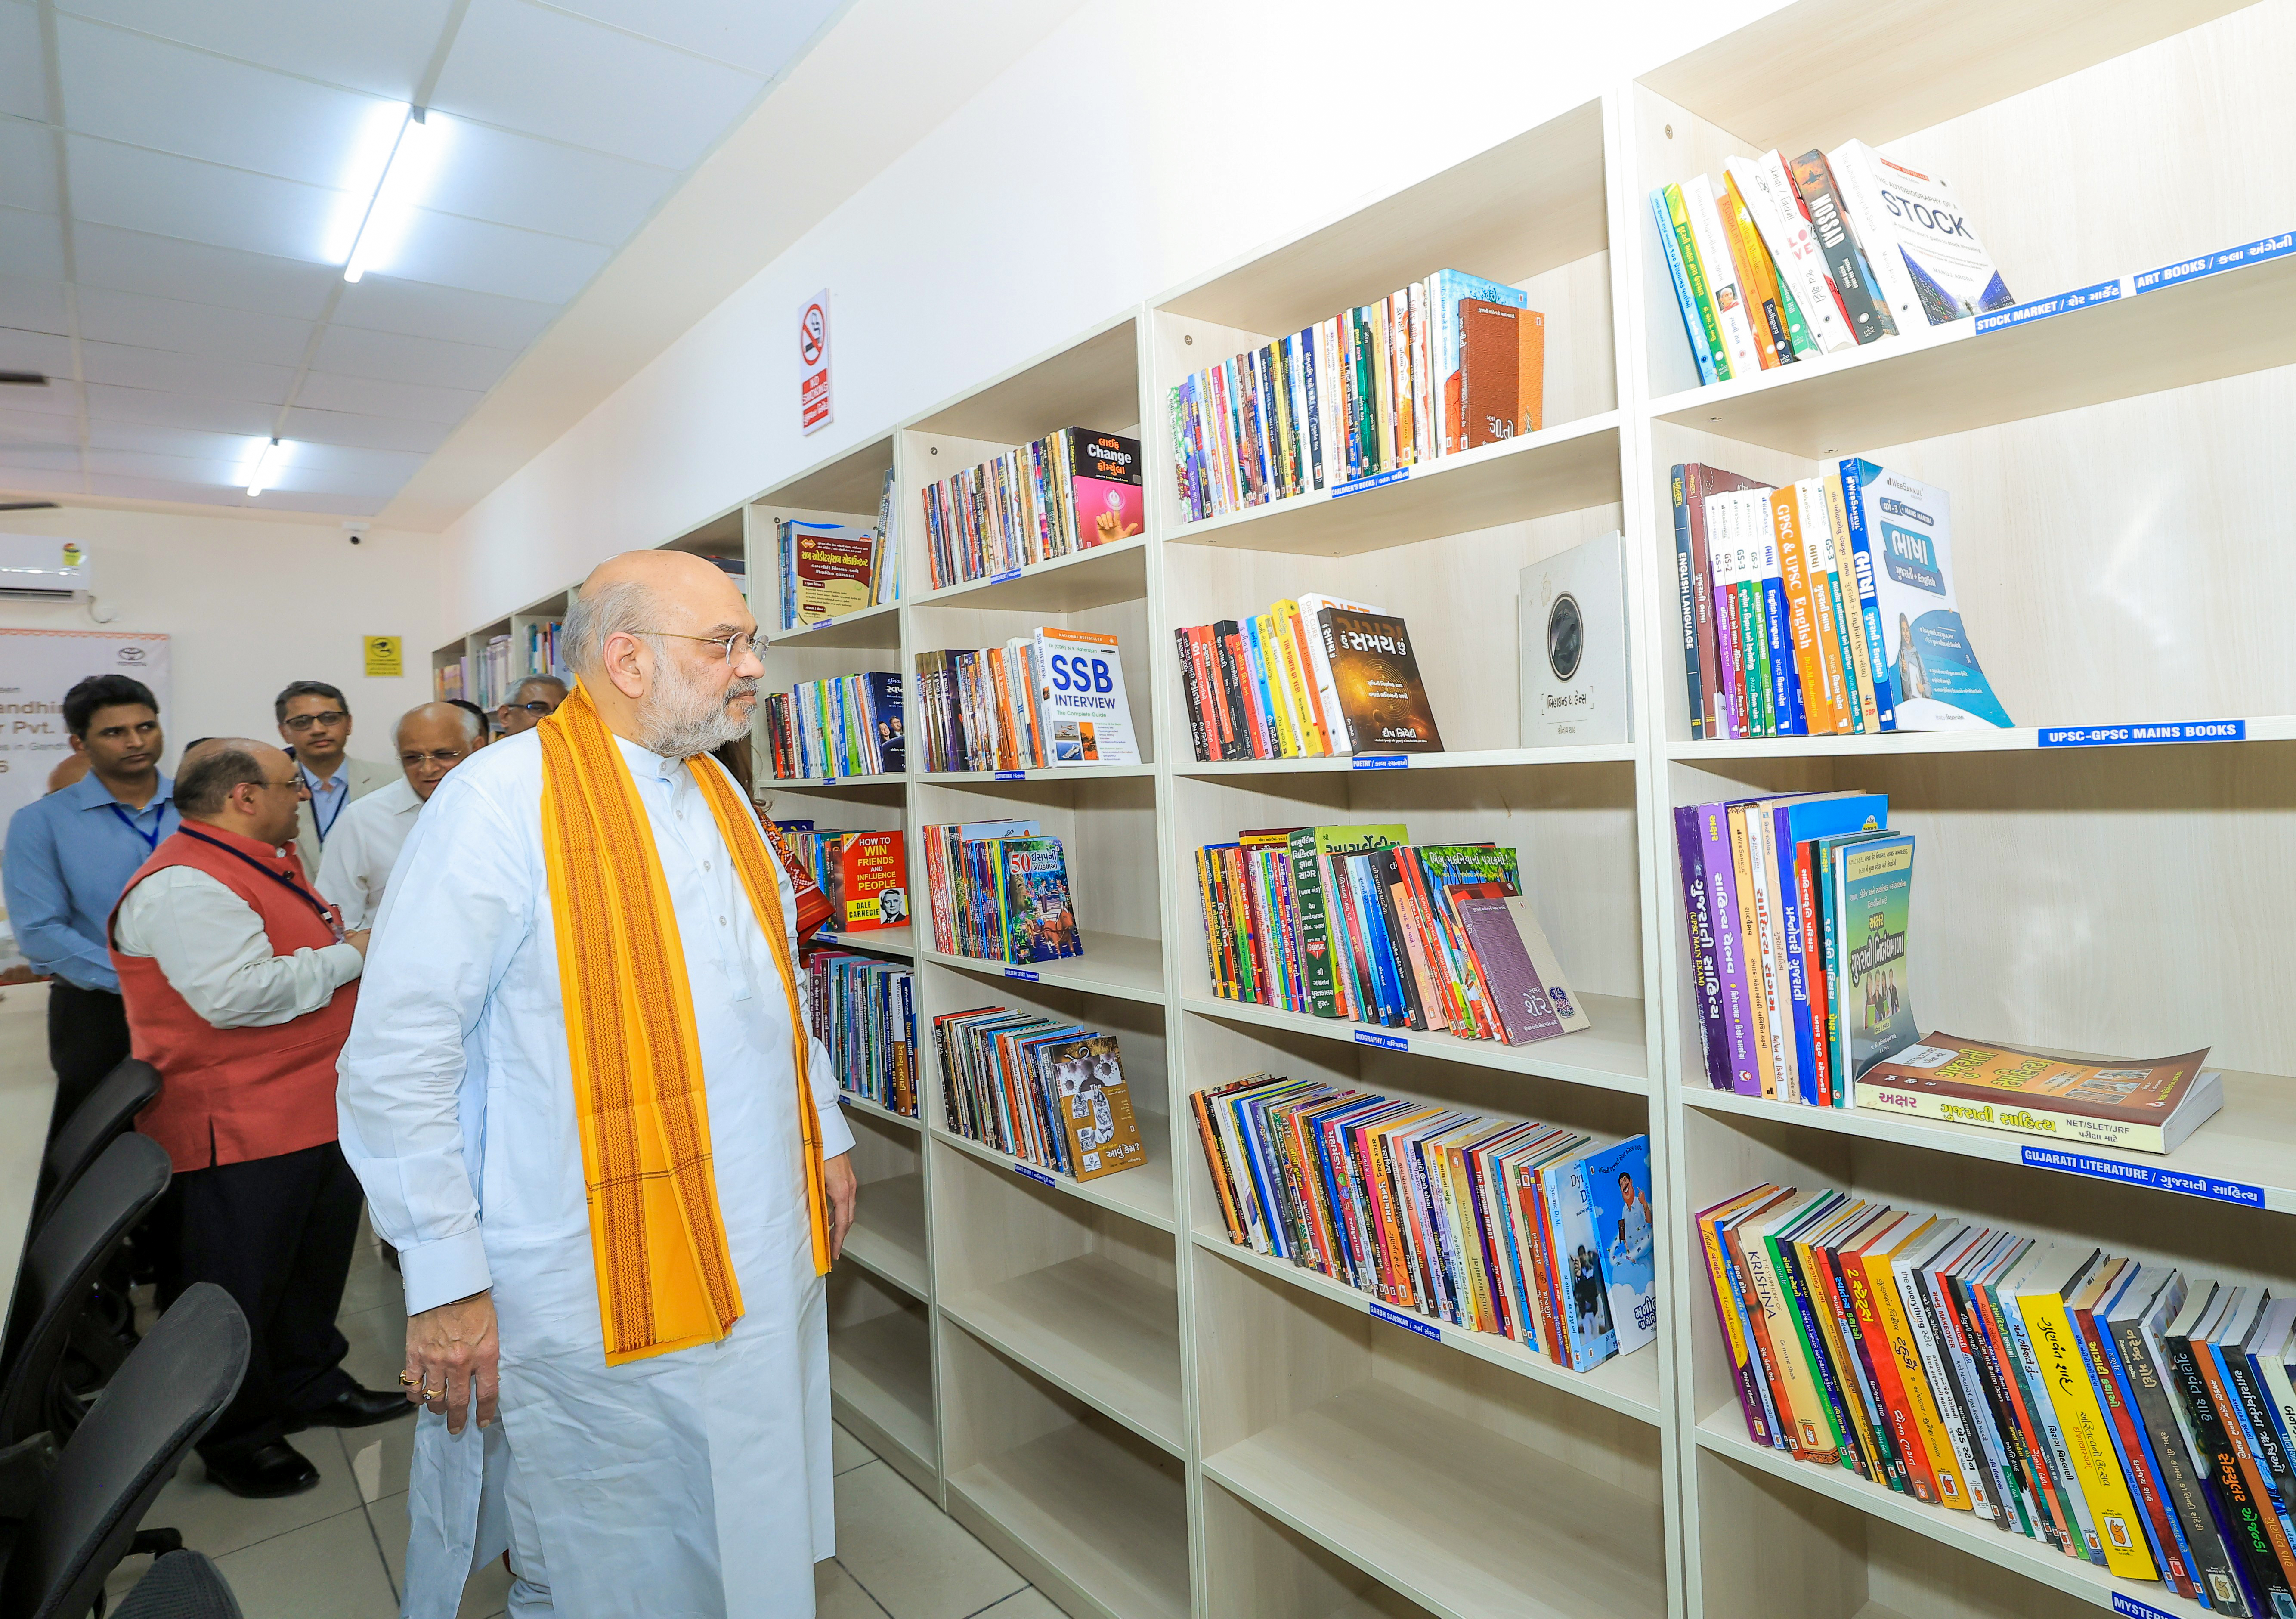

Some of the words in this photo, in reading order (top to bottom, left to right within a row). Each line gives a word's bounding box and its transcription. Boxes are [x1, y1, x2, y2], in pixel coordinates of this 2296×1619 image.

[1881, 158, 1902, 171] NATIONAL
[1902, 167, 1929, 181] BESTSELLER
[1875, 174, 1888, 185] THE
[1890, 181, 1941, 204] AUTOBIOGRAPHY
[1722, 201, 1742, 245] KUNDALINI
[1810, 192, 1845, 249] MOSSAD
[1881, 190, 1974, 240] STOCK
[2137, 273, 2160, 288] ART
[2164, 259, 2206, 282] BOOKS
[2218, 251, 2243, 265] કલા
[2250, 234, 2292, 256] અંગેની
[1933, 267, 1953, 277] MANOJ
[1955, 274, 1974, 282] ARORA
[1767, 303, 1779, 335] Sadhguru
[1977, 313, 2011, 331] STOCK
[2014, 300, 2058, 322] MARKET
[2067, 295, 2085, 306] શેર
[802, 381, 828, 404] SMOKING
[809, 375, 820, 388] NO
[1489, 419, 1514, 439] ગીતો
[1087, 443, 1132, 465] Change
[1098, 437, 1120, 451] લાઈફ
[1332, 483, 1358, 496] CHILDREN'S
[1359, 479, 1374, 489] BOOKS
[1392, 471, 1408, 481] સાહિત્ય
[1777, 504, 1795, 539] GPSC
[1904, 506, 1916, 520] MAINS
[1917, 511, 1932, 524] MANTRA
[1784, 542, 1797, 553] &
[1892, 529, 1928, 566] ભાષા
[1737, 549, 1746, 570] GS-3
[1679, 552, 1691, 594] ENGLISH
[1786, 555, 1803, 590] UPSC
[1855, 551, 1875, 598] ભાષા
[1895, 565, 1913, 584] ગુજરાતી
[1917, 576, 1936, 588] English
[1767, 589, 1779, 614] English
[1682, 595, 1696, 649] LANGUAGE
[1769, 615, 1782, 649] Language
[1794, 597, 1814, 648] English
[1076, 645, 1097, 653] Natarajan
[1340, 630, 1350, 649] હું
[1348, 631, 1396, 654] સમય
[1396, 638, 1407, 656] છું
[1287, 651, 1296, 671] POWER
[1051, 654, 1113, 693] SSB
[1055, 694, 1115, 709] INTERVIEW
[1547, 693, 1568, 709] બિહાઇન્ડ
[1569, 697, 1574, 706] ધ
[1575, 690, 1587, 704] લેન્સ
[1865, 708, 1876, 716] CBP
[13, 721, 55, 734] Pvt.
[2049, 729, 2128, 742] UPSC-GPSC
[2133, 726, 2180, 739] MAINS
[2186, 724, 2236, 737] BOOKS
[859, 838, 879, 846] HOW
[864, 845, 887, 857] WIN
[1290, 835, 1314, 847] આયુર્વેદીય
[858, 856, 894, 867] FRIENDS
[1011, 853, 1031, 873] 50
[1031, 848, 1057, 861] ઈસપની
[1292, 849, 1316, 860] ચિકિત્સા
[1298, 860, 1313, 870] જ્ઞાન
[1482, 853, 1509, 865] પરાક્રમો!
[857, 871, 896, 881] INFLUENCE
[1033, 862, 1058, 871] બોધકથાઓ
[1297, 870, 1316, 879] સાગર
[858, 879, 896, 891] PEOPLE
[849, 908, 879, 919] CARNEGIE
[857, 901, 871, 910] DALE
[1689, 877, 1714, 950] ગુજરાતી
[1690, 911, 1701, 935] (UPSC
[1756, 887, 1774, 955] સાહિત્ય
[1869, 914, 1884, 929] અક્ષર
[1308, 942, 1325, 950] Gajanan
[1693, 936, 1703, 958] MAIN
[1851, 938, 1873, 984] ગુજરાતી
[1875, 933, 1904, 964] નિબંધમાળા
[1696, 959, 1707, 987] EXAM)
[1764, 962, 1780, 1012] સંગમ
[1356, 1033, 1382, 1044] BIOGRAPHY
[897, 1044, 906, 1066] રેવન્યુ
[1878, 1092, 1917, 1108] અક્ષર
[1940, 1103, 1994, 1122] ગુજરાતી
[2000, 1111, 2057, 1133] સાહિત્ય
[2066, 1119, 2130, 1134] NET/SLET/JRF
[1106, 1147, 1123, 1159] આવું
[1124, 1143, 1140, 1155] કેમ?
[2024, 1150, 2077, 1168] GUJARATI
[2080, 1158, 2149, 1181] LITERATURE
[2160, 1174, 2207, 1192] ગુજરાતી
[2212, 1186, 2257, 1201] સાહિત્ય
[1380, 1181, 1393, 1222] પુનરાગમન
[1479, 1184, 1488, 1214] COMPOUND
[1485, 1216, 1494, 1239] IMPACT
[1750, 1250, 1776, 1318] KRISHNA
[1847, 1267, 1860, 1278] 2
[1902, 1271, 1911, 1283] the
[1767, 1270, 1779, 1302] SYMPHONY
[1776, 1303, 1782, 1311] OF
[1848, 1278, 1878, 1324] સ્ટેટ્સ
[1906, 1284, 1926, 1328] everything
[1370, 1306, 1386, 1318] GARBH
[1387, 1313, 1409, 1328] SANSKAR
[1413, 1324, 1423, 1332] ગર્ભ
[1424, 1328, 1440, 1339] સંસ્કાર
[1939, 1309, 1956, 1348] MAKEOVER
[1922, 1329, 1934, 1347] સ્ટોર
[2037, 1315, 2067, 1361] ગુણવંત
[2055, 1361, 2076, 1397] શાહ
[2089, 1340, 2109, 1375] આઝાદી
[2102, 1376, 2121, 1408] કથાઓ
[2216, 1451, 2249, 1504] સેક્યુલર
[2241, 1505, 2270, 1554] એજન્ડા
